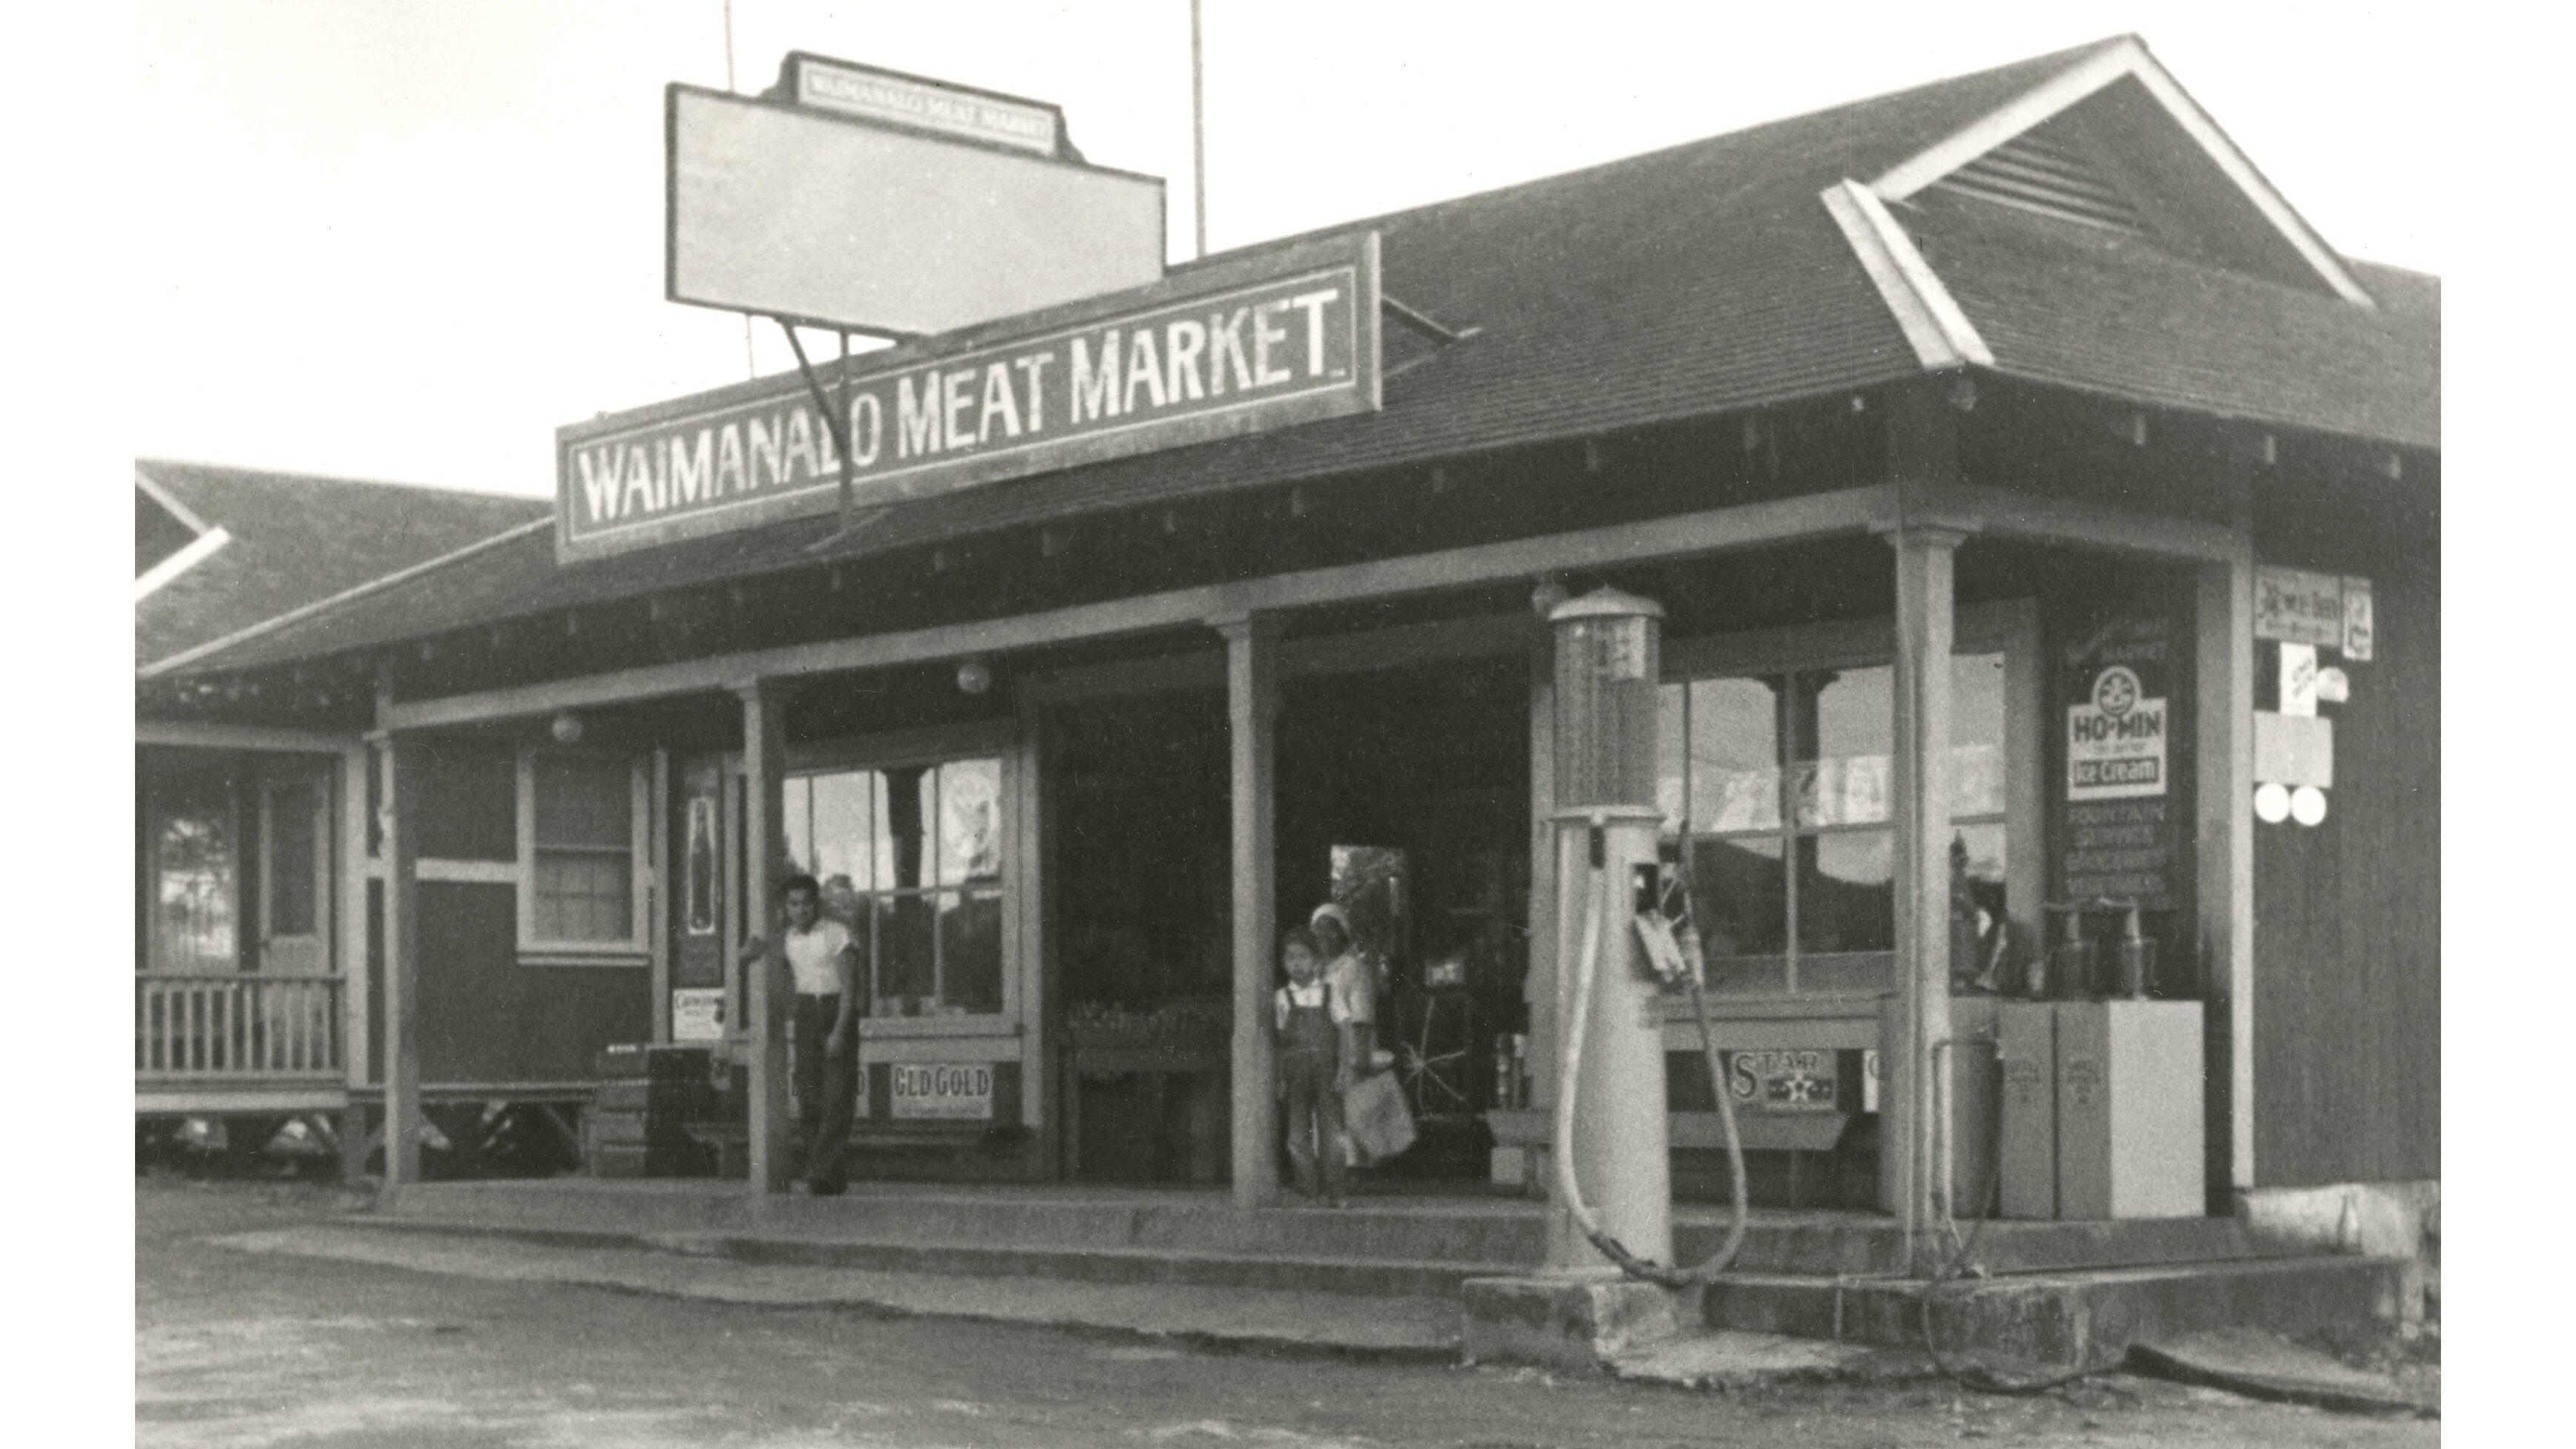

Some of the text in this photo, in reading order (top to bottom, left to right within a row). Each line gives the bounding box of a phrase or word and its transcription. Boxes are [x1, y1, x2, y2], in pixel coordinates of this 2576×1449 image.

[578, 289, 1338, 523] WAIMANALO MEAT MARKET
[2100, 760, 2157, 782] Cream
[2069, 804, 2166, 825] FOUNTAIN
[935, 1065, 989, 1097] GOLD
[1733, 1051, 1818, 1101] STAR
